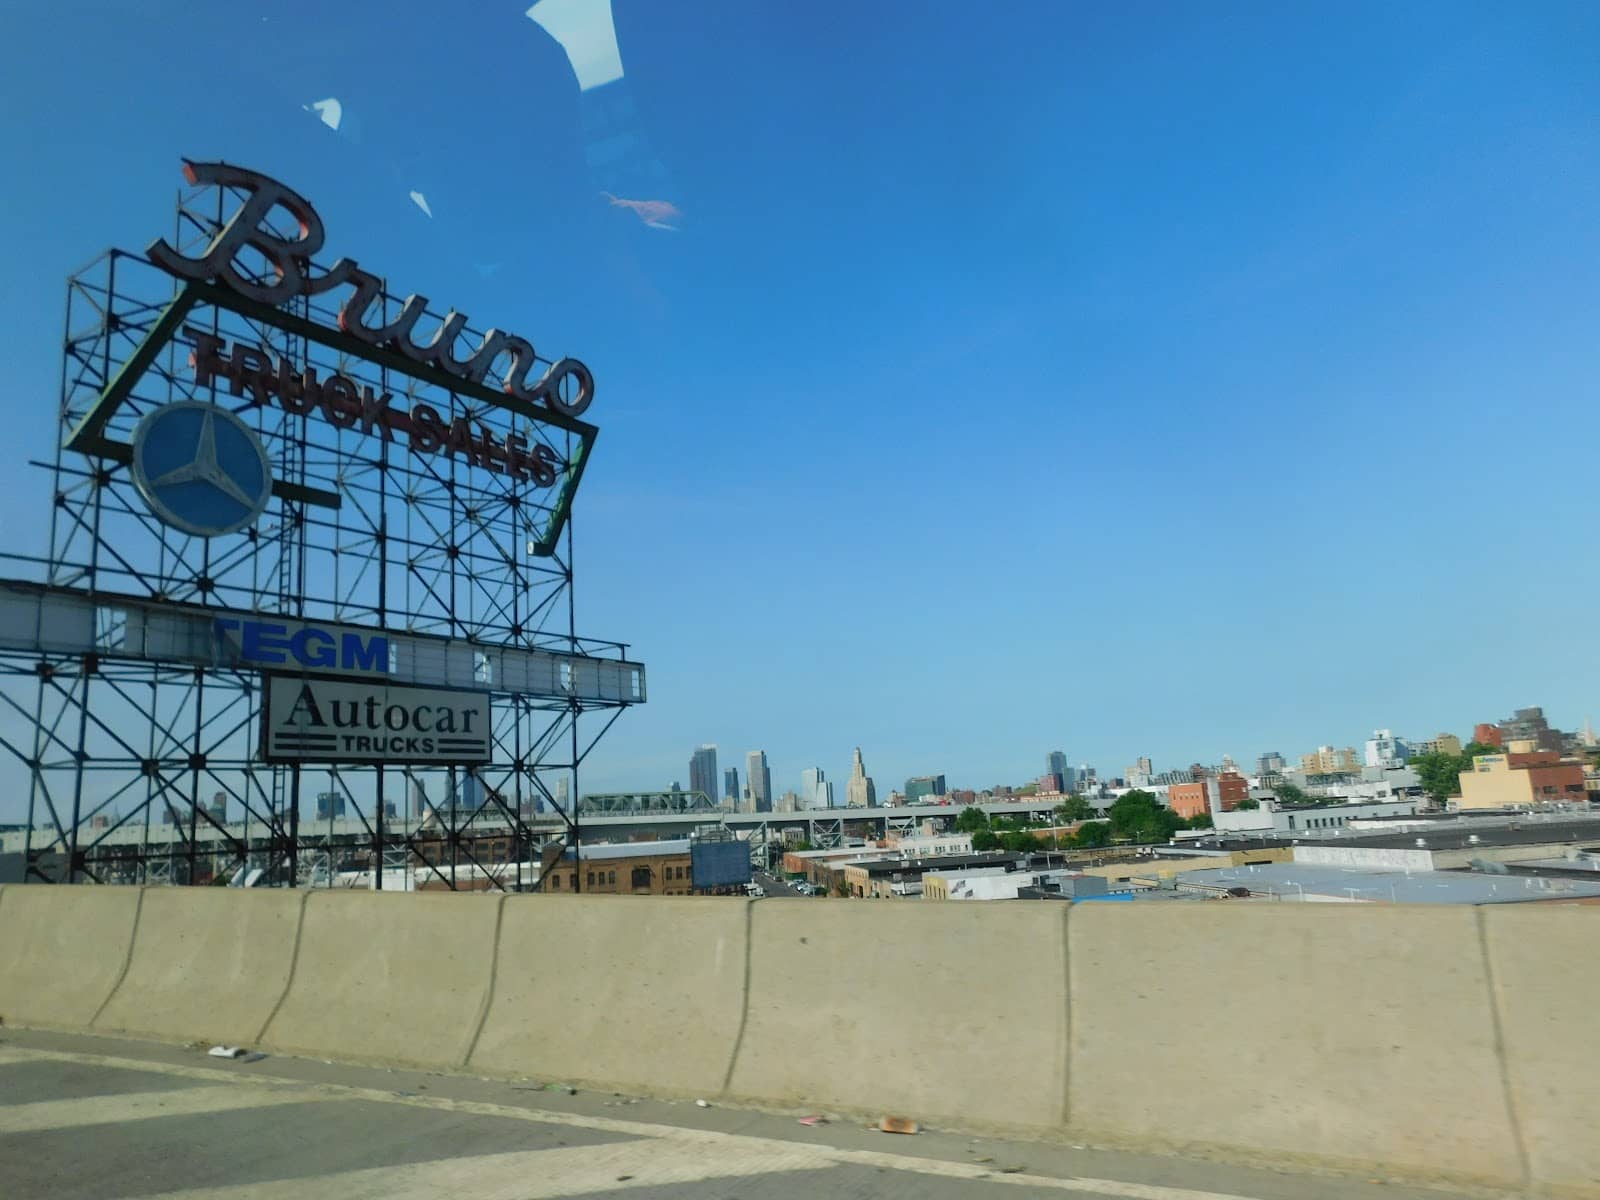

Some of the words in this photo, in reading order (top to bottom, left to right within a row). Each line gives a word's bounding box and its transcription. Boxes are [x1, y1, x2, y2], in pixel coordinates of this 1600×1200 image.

[146, 158, 594, 416] Bruno
[183, 325, 394, 441] TRUCK
[410, 404, 556, 487] SALES
[283, 684, 479, 733] Autocar
[341, 735, 434, 753] TRUCKS
